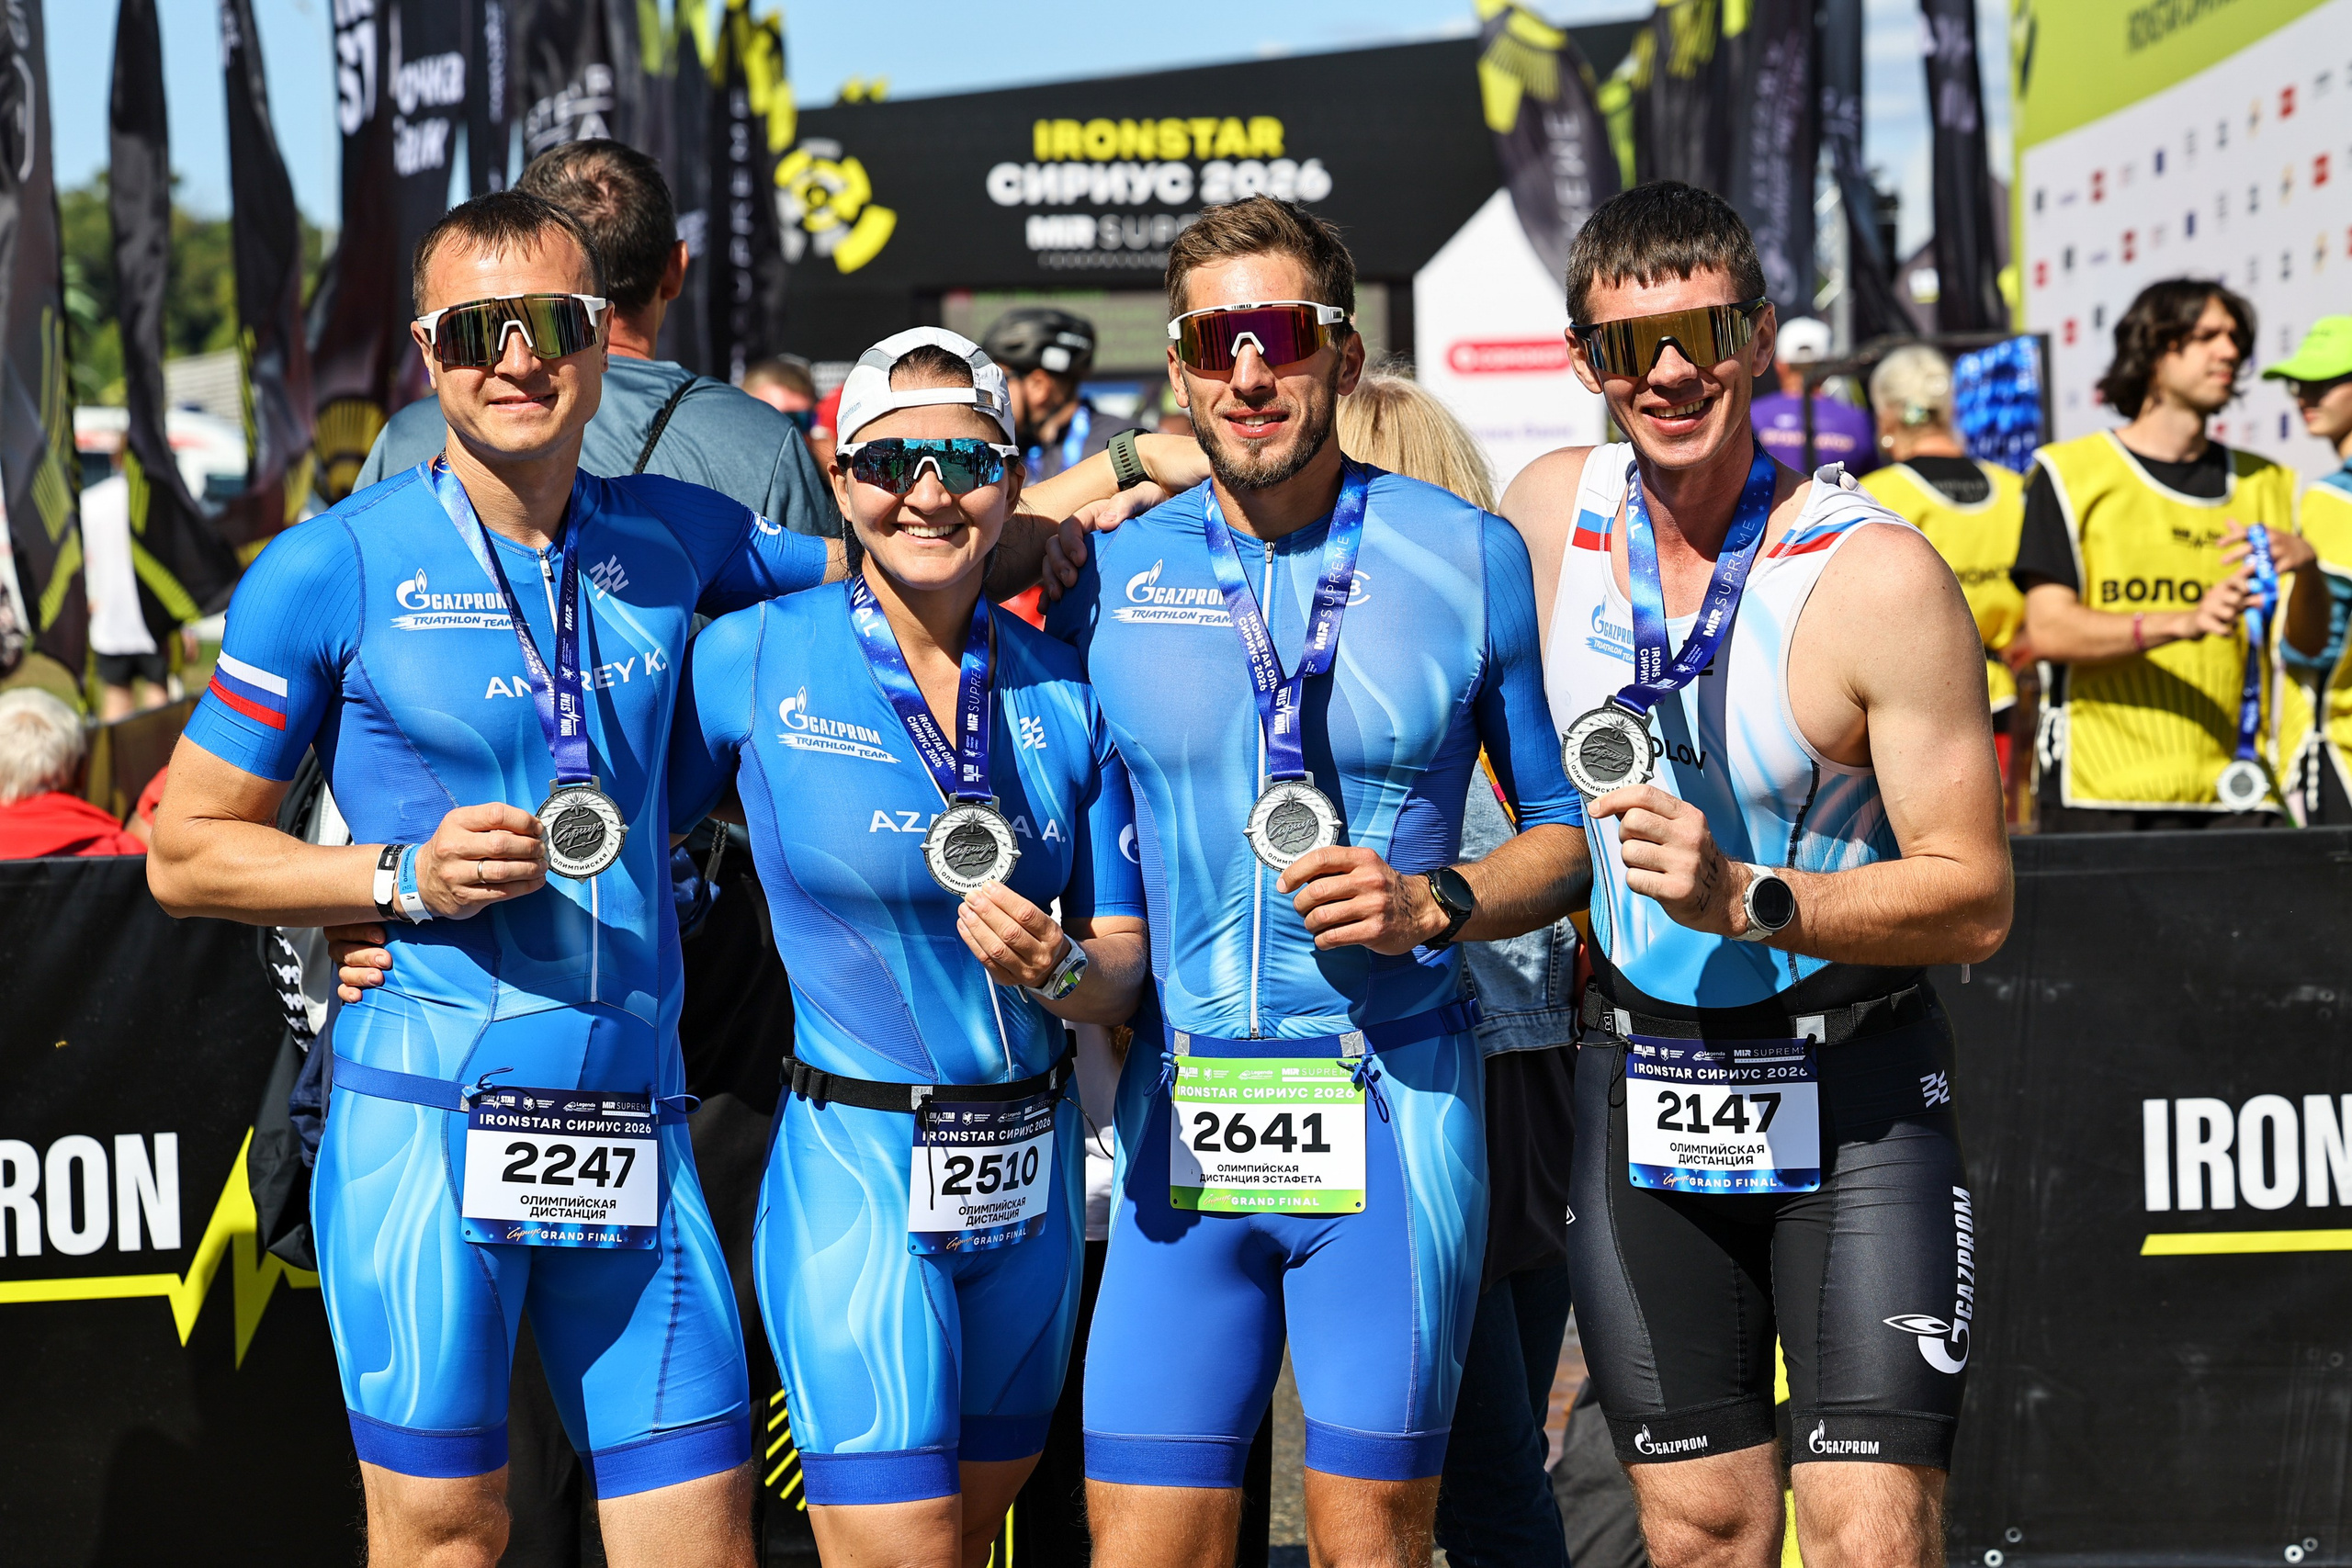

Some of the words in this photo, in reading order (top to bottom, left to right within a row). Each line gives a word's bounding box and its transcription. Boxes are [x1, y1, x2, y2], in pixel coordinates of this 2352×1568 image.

[1033, 116, 1285, 162] IRONSTAR
[986, 162, 1194, 207] СИРИУС
[1199, 158, 1332, 205] 2026
[1702, 608, 1724, 637] MIR
[1715, 519, 1755, 607] SUPREME
[430, 592, 513, 611] GAZPROM
[1314, 621, 1330, 650] MIR
[1323, 534, 1350, 620] SUPREME
[2101, 578, 2203, 604] ВОЛО
[854, 575, 876, 638] INAL
[1131, 608, 1198, 621] TRIATHLON
[413, 614, 481, 626] TRIATHLON
[483, 618, 514, 628] TEAM
[564, 604, 574, 632] MIR
[1248, 610, 1272, 670] IRONSTAR
[1594, 639, 1623, 656] TRIATHLON
[1238, 616, 1261, 663] СИРИУС
[1254, 661, 1267, 692] 2026
[1651, 646, 1661, 678] IRONS
[484, 655, 636, 700] ANREY
[645, 647, 668, 676] K.
[1640, 648, 1649, 684] СИРИУ
[967, 649, 984, 713] SUPREME
[560, 692, 571, 712] STAR
[1276, 686, 1288, 707] STAR
[560, 718, 572, 737] IRON
[808, 715, 883, 747] GAZPROM
[917, 713, 946, 753] IRONSTAR
[967, 713, 979, 732] MIR
[1274, 713, 1286, 735] IRON
[795, 736, 856, 753] TRIATHLON
[856, 749, 889, 761] TEAM
[906, 716, 931, 750] СИРИУС
[925, 747, 944, 769] 2026
[1651, 735, 1707, 771] OLOV
[1041, 818, 1067, 843] A.
[552, 852, 608, 871] ОЛИМПИЙСКАЯ
[1734, 1049, 1752, 1057] MIR
[1282, 1067, 1300, 1076] MIR
[1634, 1063, 1692, 1079] IRONSTAR
[1697, 1068, 1760, 1080] СИРИУС
[500, 1095, 516, 1103] STAR
[1177, 1085, 1238, 1099] IRONSTAR
[1243, 1087, 1308, 1099] СИРИУС
[1314, 1087, 1355, 1099] 2026
[602, 1100, 616, 1110] MIR
[616, 1101, 650, 1111] SUPREME
[942, 1111, 956, 1120] STAR
[1657, 1089, 1781, 1134] 2147
[479, 1113, 561, 1130] IRONSTAR
[566, 1119, 621, 1133] СИРИУС
[624, 1122, 652, 1134] 2026
[922, 1130, 995, 1142] IRONSTAR
[999, 1123, 1034, 1140] СИРИУС
[1035, 1117, 1051, 1131] 2026
[1193, 1111, 1330, 1154] 2641
[1669, 1142, 1765, 1155] ОЛИМПИЙСКАЯ
[2143, 1094, 2352, 1212] IRON
[502, 1141, 636, 1189] 2247
[941, 1145, 1039, 1195] 2510
[1216, 1163, 1299, 1173] ОЛИМПИЙСКАЯ
[1678, 1155, 1754, 1167] ДИСТАНЦИЯ
[1199, 1173, 1261, 1184] ДИСТАНЦИЯ
[1262, 1175, 1322, 1184] ЭСТАФЕТА
[1689, 1177, 1732, 1188] GRAND
[1736, 1178, 1777, 1187] FINAL
[0, 1132, 181, 1258] RON
[520, 1194, 617, 1210] ОЛИМПИЙСКАЯ
[1231, 1196, 1275, 1206] GRAND
[1279, 1197, 1320, 1206] FINAL
[529, 1207, 607, 1221] ДИСТАНЦИЯ
[958, 1196, 1026, 1216] ОЛИМПИЙСКАЯ
[966, 1209, 1020, 1227] ДИСТАНЦИЯ
[540, 1231, 584, 1241] GRAND
[588, 1232, 623, 1243] FINAL
[973, 1234, 1004, 1246] GRAND
[1006, 1227, 1027, 1240] FINAL
[1951, 1185, 1975, 1321] GAZPROM
[1655, 1435, 1708, 1455] GAZPROM
[1826, 1439, 1880, 1455] GAZPROM
